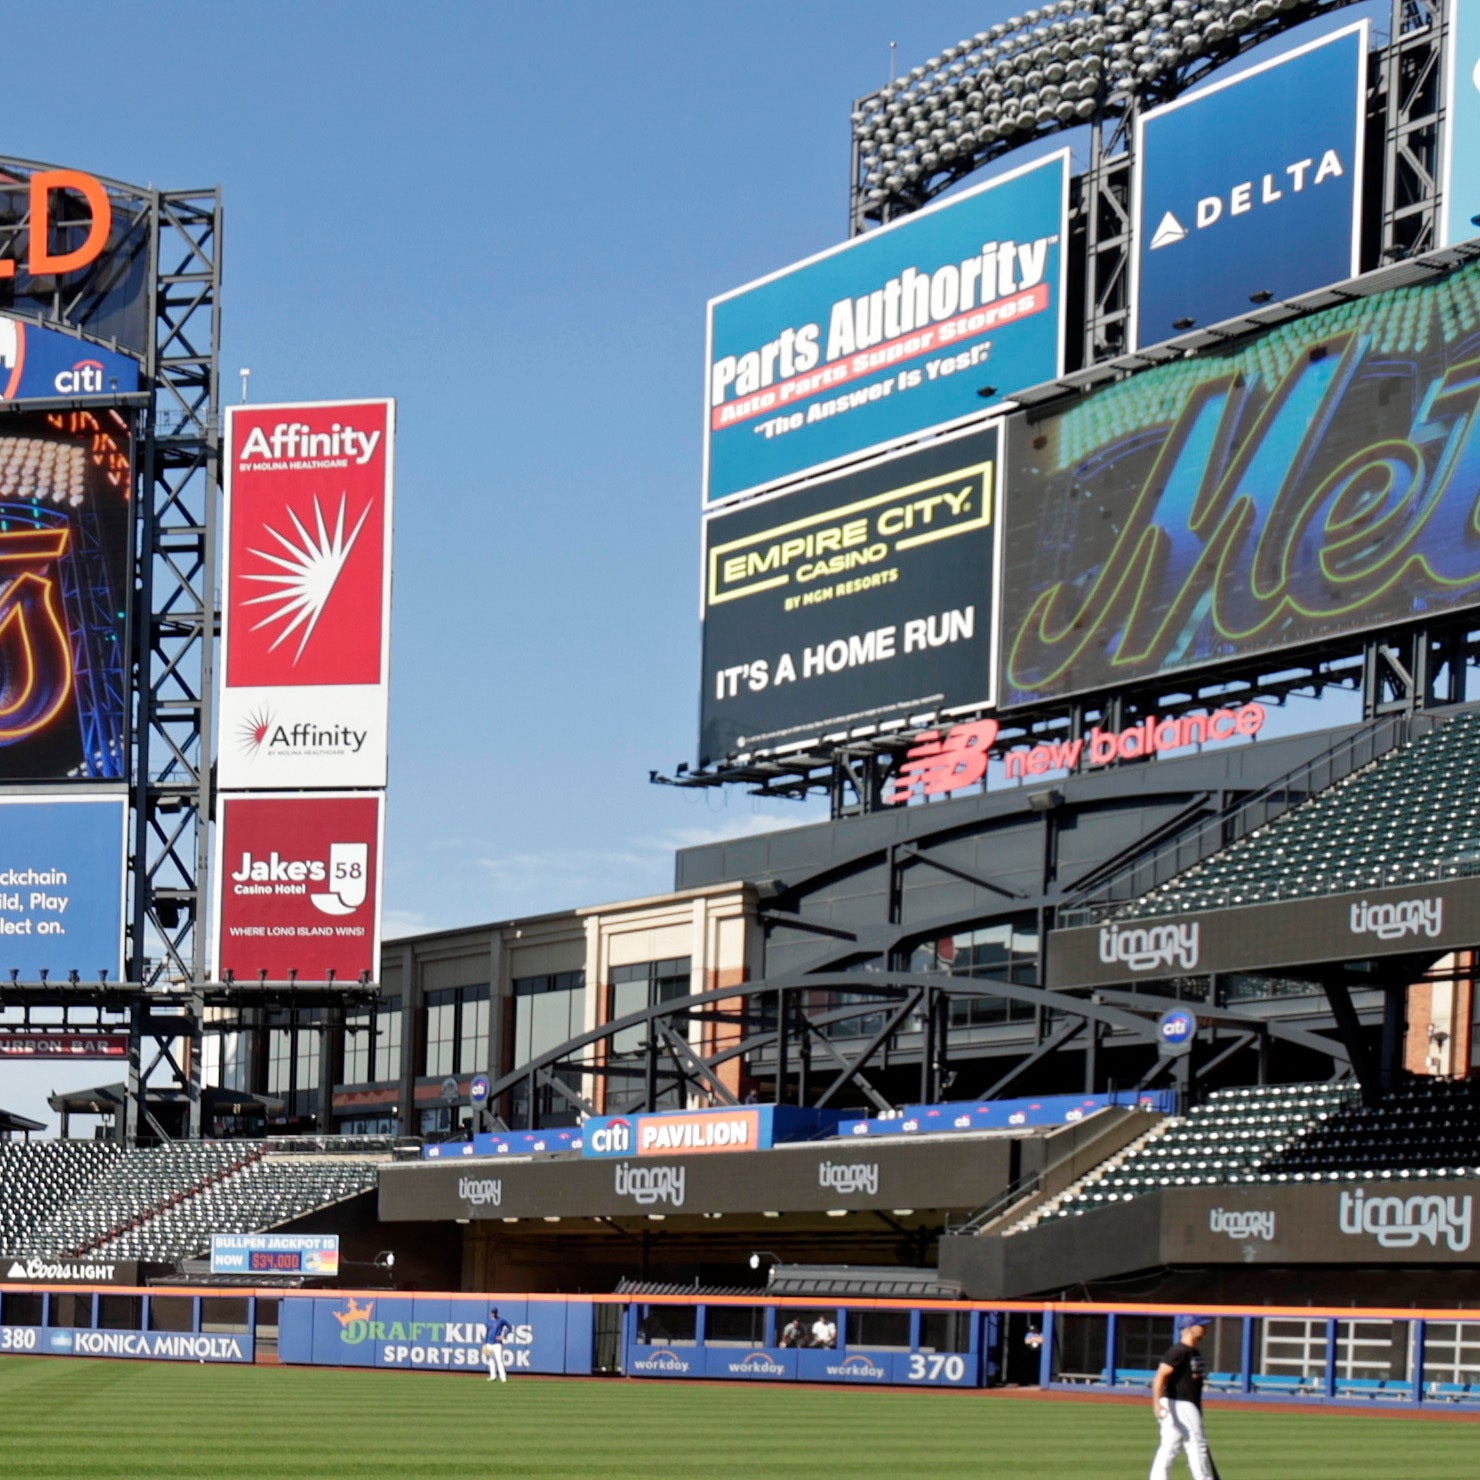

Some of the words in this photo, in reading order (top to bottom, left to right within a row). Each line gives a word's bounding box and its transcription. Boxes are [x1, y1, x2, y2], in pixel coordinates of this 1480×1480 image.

[1196, 148, 1344, 231] DELTA
[712, 322, 820, 407] Parts
[826, 240, 1049, 362] Authority
[720, 389, 776, 424] Auto
[780, 363, 847, 400] Parts
[852, 330, 934, 381] Super
[938, 294, 1035, 346] Stores
[54, 368, 103, 393] citi
[807, 377, 895, 424] Answer
[898, 367, 922, 391] Is
[240, 422, 381, 465] Affinity
[239, 463, 251, 472] BY
[253, 461, 289, 471] MOLINA
[289, 459, 348, 469] HEALTHCARE
[1006, 326, 1480, 691] Me
[724, 518, 869, 584] EMPIRE
[877, 486, 975, 536] CITY
[796, 542, 888, 583] CASINO
[784, 595, 801, 611] BY
[803, 586, 833, 606] MGM
[836, 567, 899, 598] RESORTS
[716, 659, 769, 700] IT'S
[774, 653, 797, 686] A
[803, 625, 897, 679] HOME
[904, 605, 975, 653] RUN
[270, 724, 367, 752] Affinity
[1005, 738, 1084, 780] new
[1090, 702, 1265, 765] balance
[231, 852, 326, 881] Jake's
[335, 862, 362, 880] 58
[30, 893, 69, 914] Play
[234, 884, 272, 895] Casino
[275, 883, 306, 894] Hotel
[37, 921, 65, 935] on.
[230, 927, 266, 936] WHERE
[267, 927, 296, 936] LONG
[297, 927, 333, 936] ISLAND
[335, 926, 365, 936] WINS!
[1350, 898, 1443, 940] timmy
[1099, 922, 1200, 971] timmy
[75, 1039, 109, 1051] BAR
[592, 1124, 628, 1152] citi
[643, 1121, 748, 1149] PAVILION
[459, 1177, 501, 1206] timmy
[615, 1162, 685, 1207] timmy
[819, 1161, 878, 1195] timmy
[1210, 1208, 1275, 1240] timmy
[1339, 1188, 1472, 1251] timmy
[216, 1237, 265, 1249] BULLPEN
[268, 1238, 321, 1249] JACKPOT
[323, 1239, 336, 1249] IS
[27, 1260, 72, 1278] Coors
[72, 1265, 115, 1280] LIGHT
[216, 1255, 243, 1266] NOW
[1, 1328, 36, 1349] 380
[75, 1332, 151, 1355] KONICA
[154, 1336, 243, 1359] MINOLTA
[908, 1355, 964, 1381] 370
